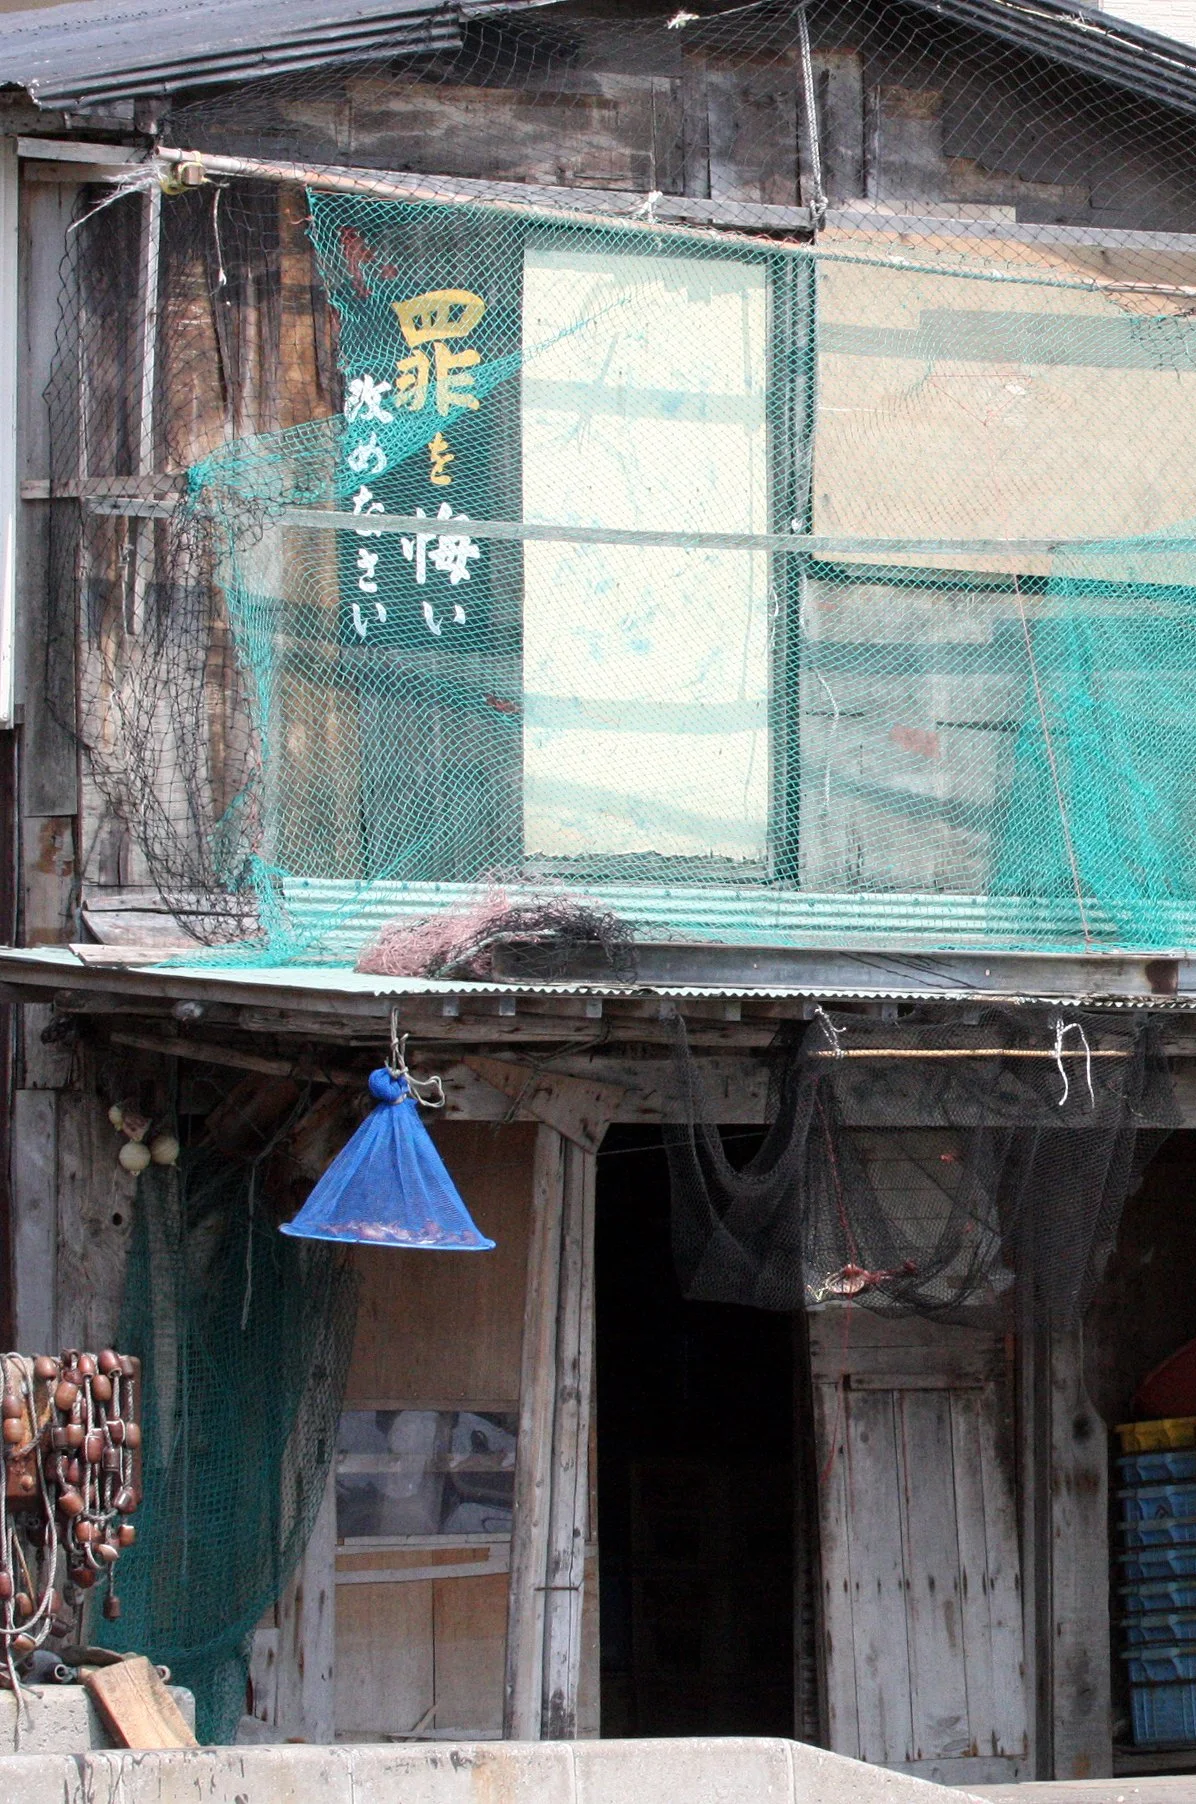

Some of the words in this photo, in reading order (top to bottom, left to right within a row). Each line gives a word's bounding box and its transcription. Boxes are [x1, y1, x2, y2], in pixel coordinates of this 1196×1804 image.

[344, 373, 393, 638] 改めなさい
[392, 289, 485, 636] 罪を悔い
